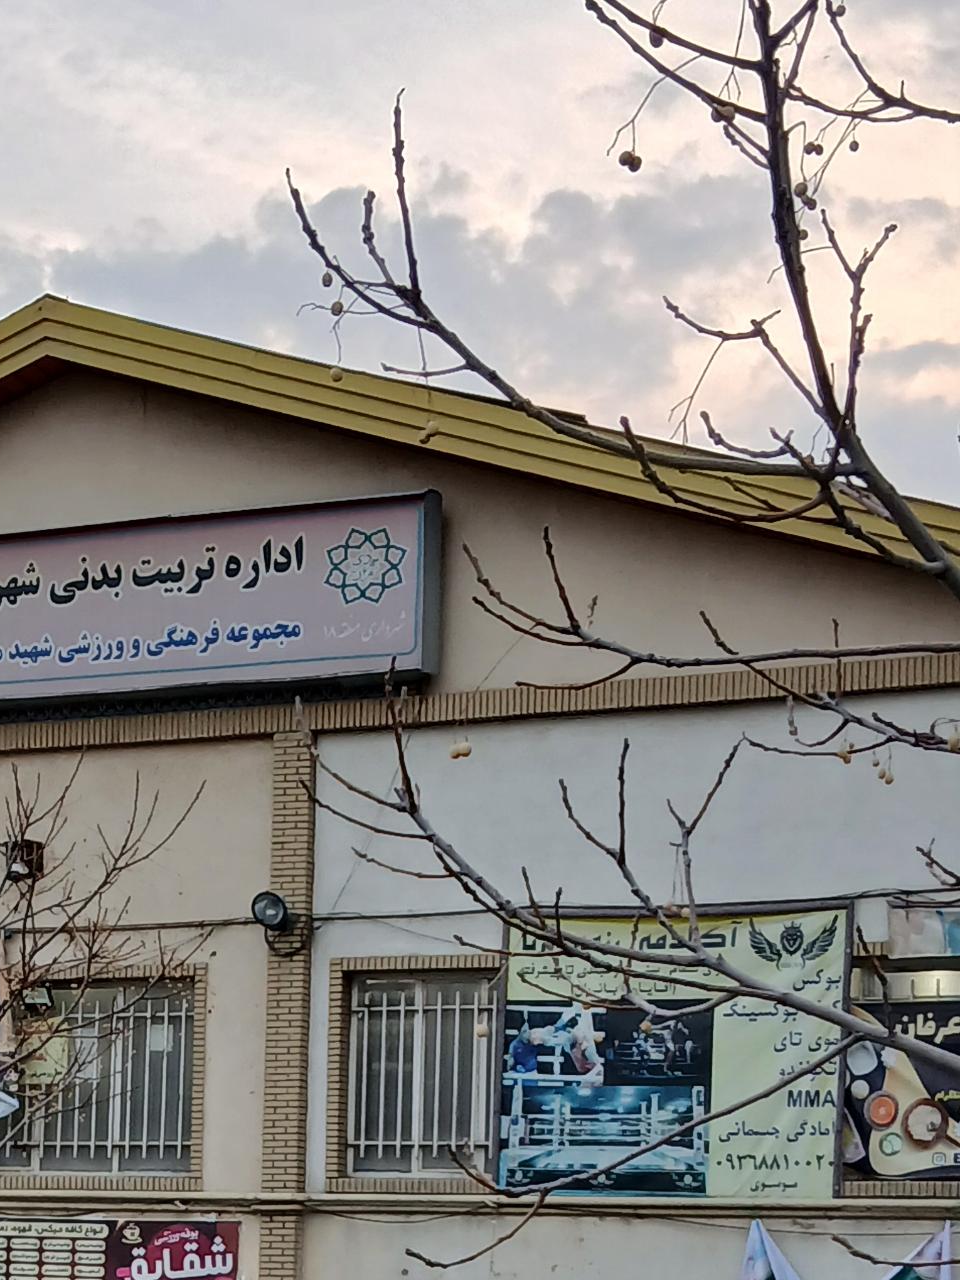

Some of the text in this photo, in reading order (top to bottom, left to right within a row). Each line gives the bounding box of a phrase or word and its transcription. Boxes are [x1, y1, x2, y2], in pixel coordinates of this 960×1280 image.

[132, 546, 217, 594] تربیت
[225, 535, 304, 590] اداره
[49, 556, 123, 604] بدنی
[58, 633, 124, 663] ورزشی
[129, 637, 141, 659] و
[146, 620, 220, 657] فرهنگی
[226, 621, 301, 650] مجموعه
[8, 637, 53, 664] شهید
[793, 969, 841, 991] بوکس
[774, 1031, 802, 1052] تای
[787, 1089, 836, 1108] MMA
[719, 1120, 780, 1142] جسمانی
